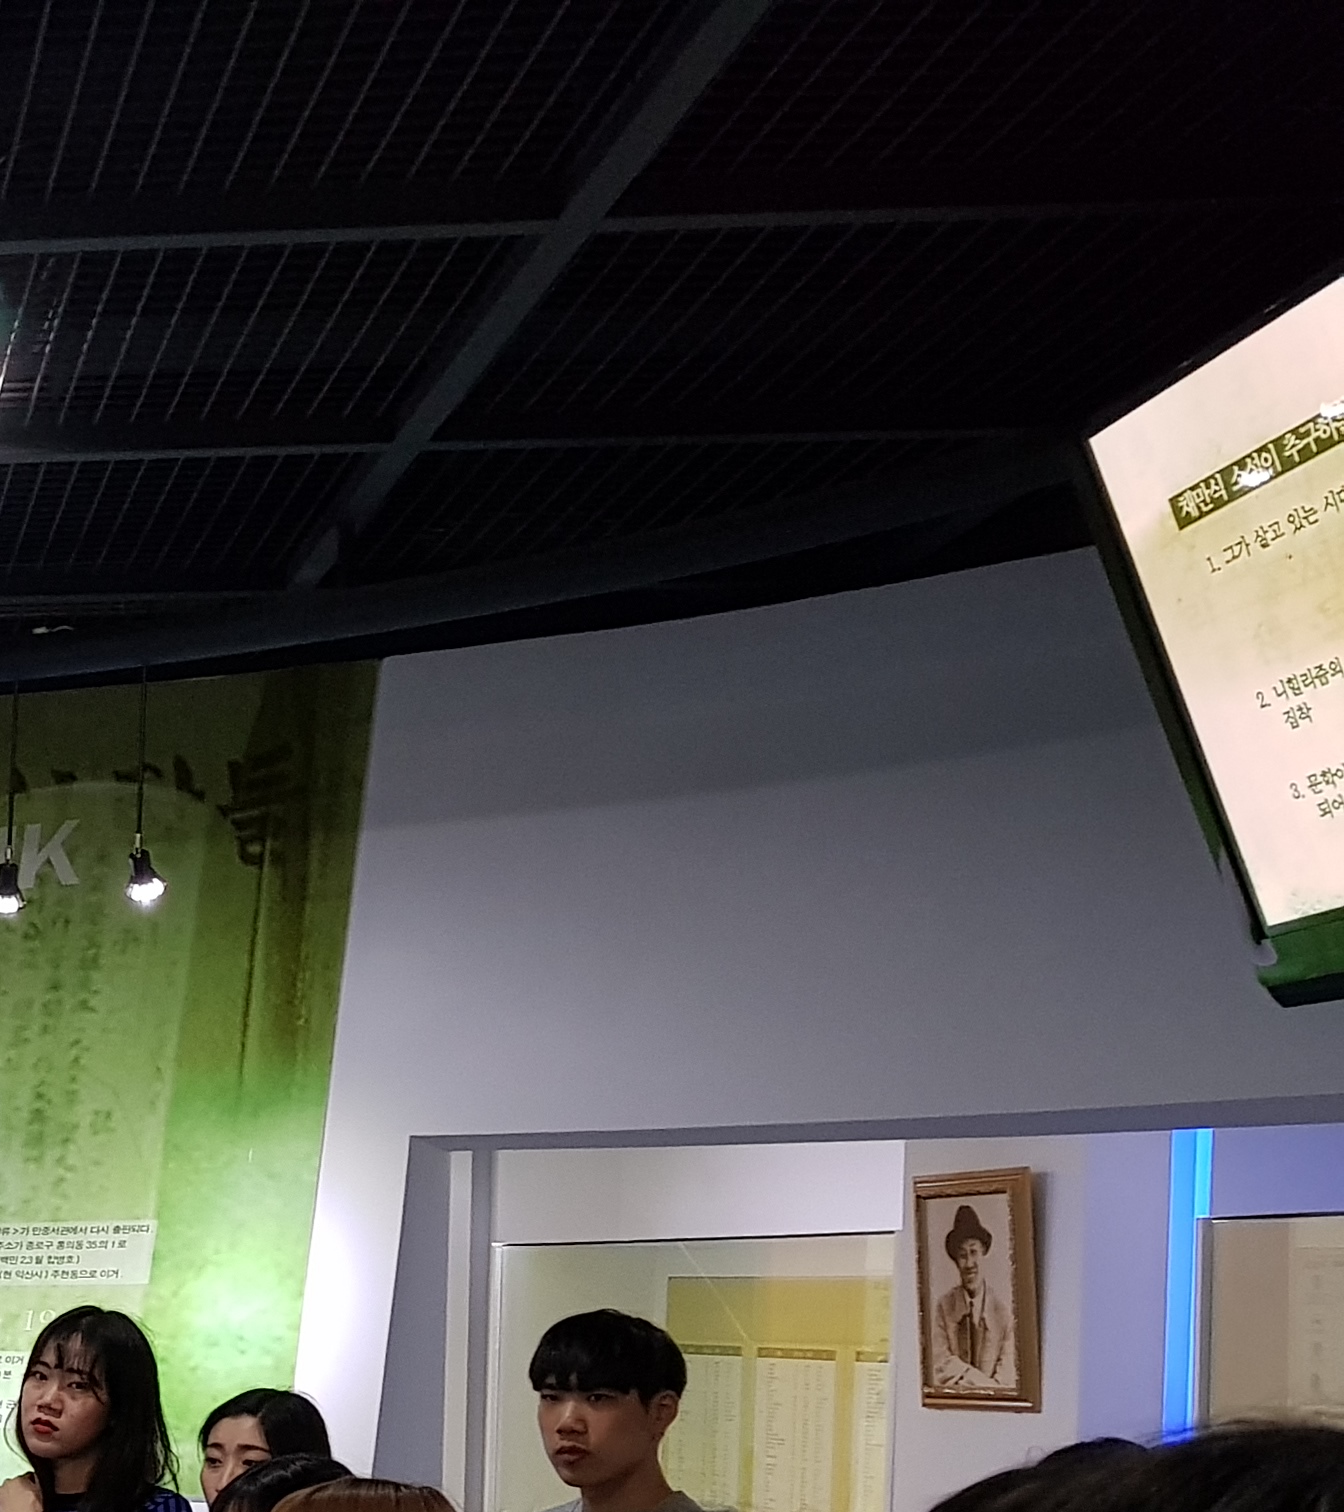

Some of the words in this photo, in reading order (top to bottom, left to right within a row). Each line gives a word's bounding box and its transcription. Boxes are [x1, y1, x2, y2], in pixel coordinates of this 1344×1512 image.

[1178, 472, 1229, 518] 채만식
[1222, 535, 1252, 564] 그가
[1254, 520, 1286, 550] 살고
[1286, 504, 1320, 535] 있는
